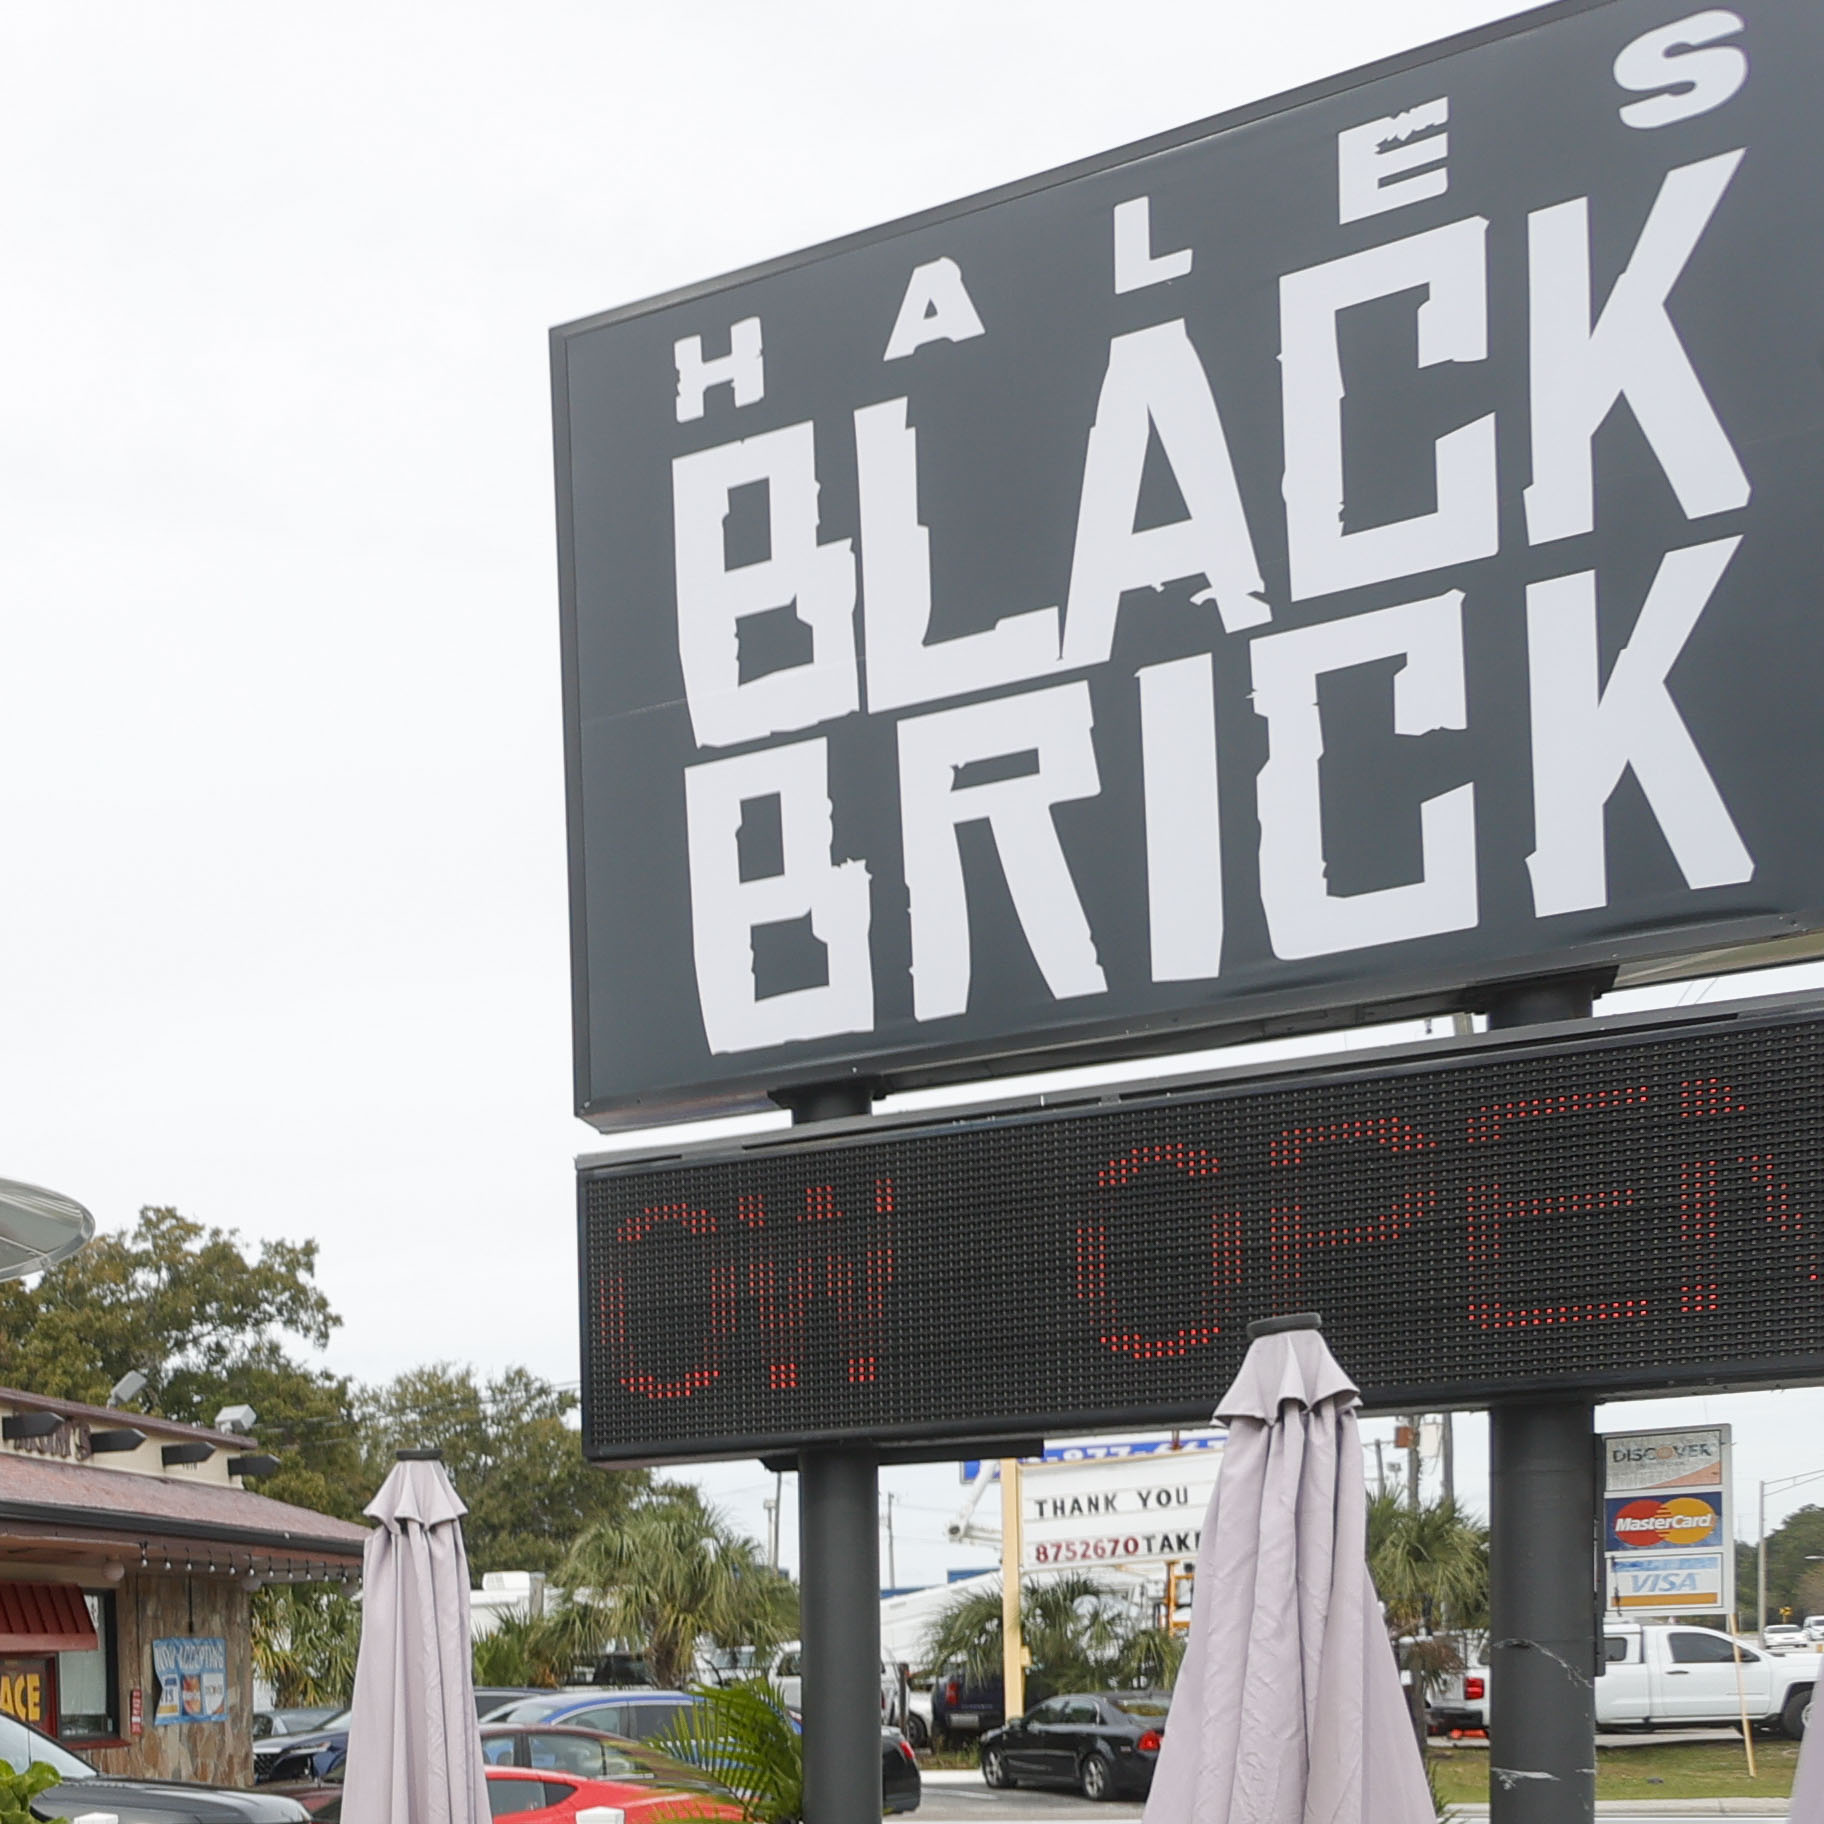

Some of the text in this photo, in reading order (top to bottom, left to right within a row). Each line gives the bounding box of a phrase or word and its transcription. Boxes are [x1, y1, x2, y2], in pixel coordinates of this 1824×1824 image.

[674, 9, 1748, 423] HALES
[671, 147, 1752, 749] BLACK
[684, 533, 1756, 1056] BRICK
[1612, 1442, 1713, 1463] DISCOVER
[1034, 1485, 1189, 1519] THANK YOU
[1614, 1513, 1713, 1532] MasterCard
[1631, 1572, 1698, 1593] VISA
